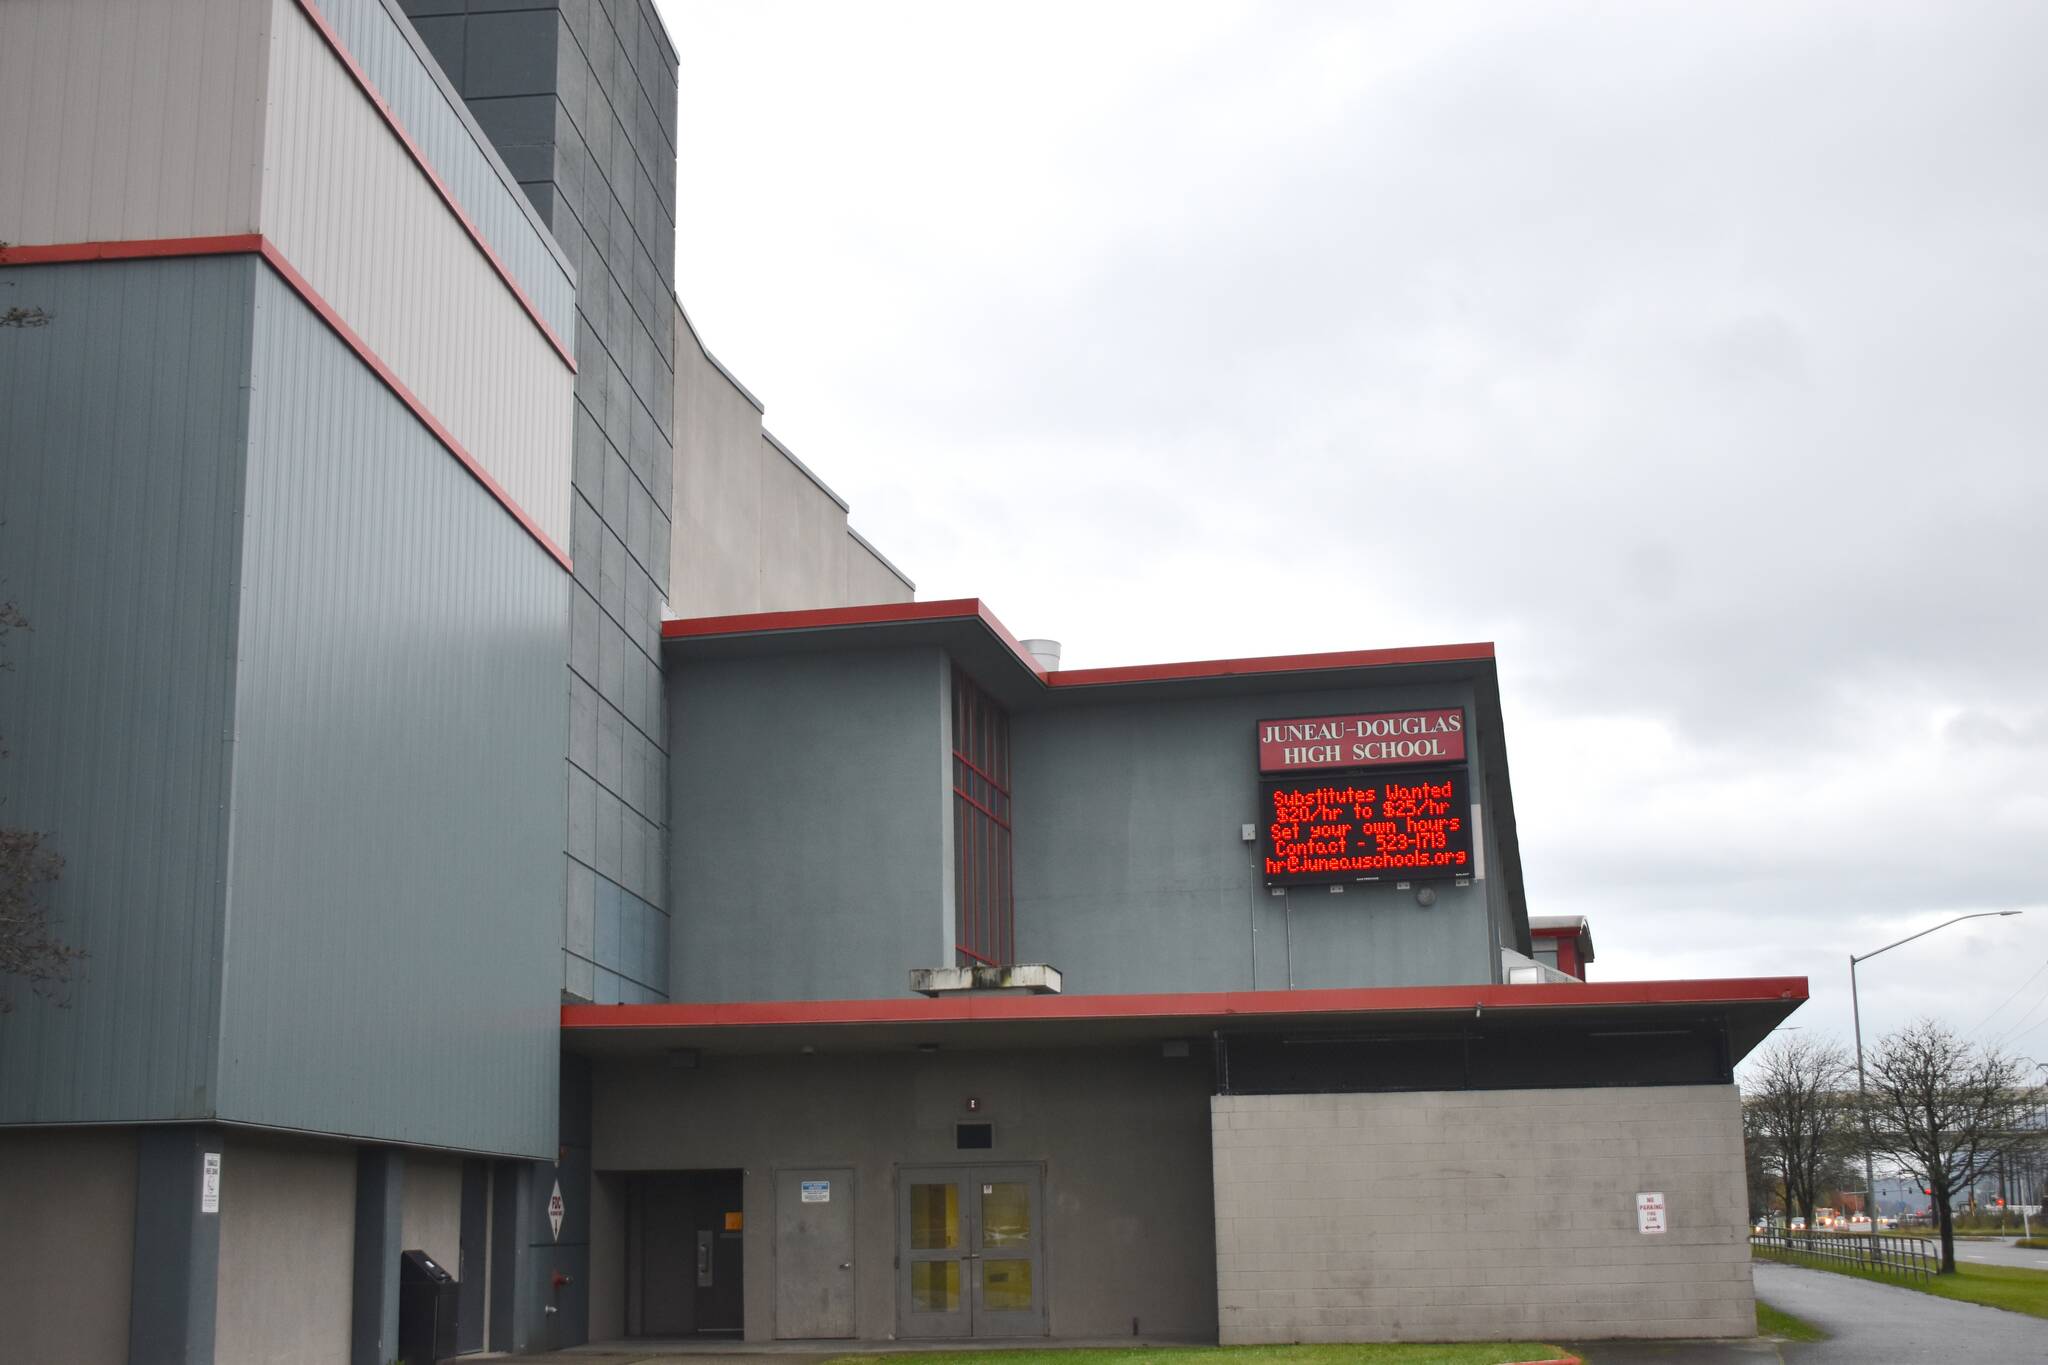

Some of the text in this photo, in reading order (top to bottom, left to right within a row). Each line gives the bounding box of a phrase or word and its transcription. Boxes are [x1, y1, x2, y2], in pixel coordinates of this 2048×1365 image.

[1262, 715, 1461, 743] JUNEAU-DOUGLAS
[1284, 739, 1446, 765] HIGH SCHOOL
[1273, 780, 1452, 807] Substitutes Wanted
[1276, 799, 1450, 823] $20/hr to $25/hr
[1270, 816, 1460, 841] Set your own hours
[1275, 838, 1347, 857] Contact
[1265, 850, 1467, 874] hr@juneauschools.org
